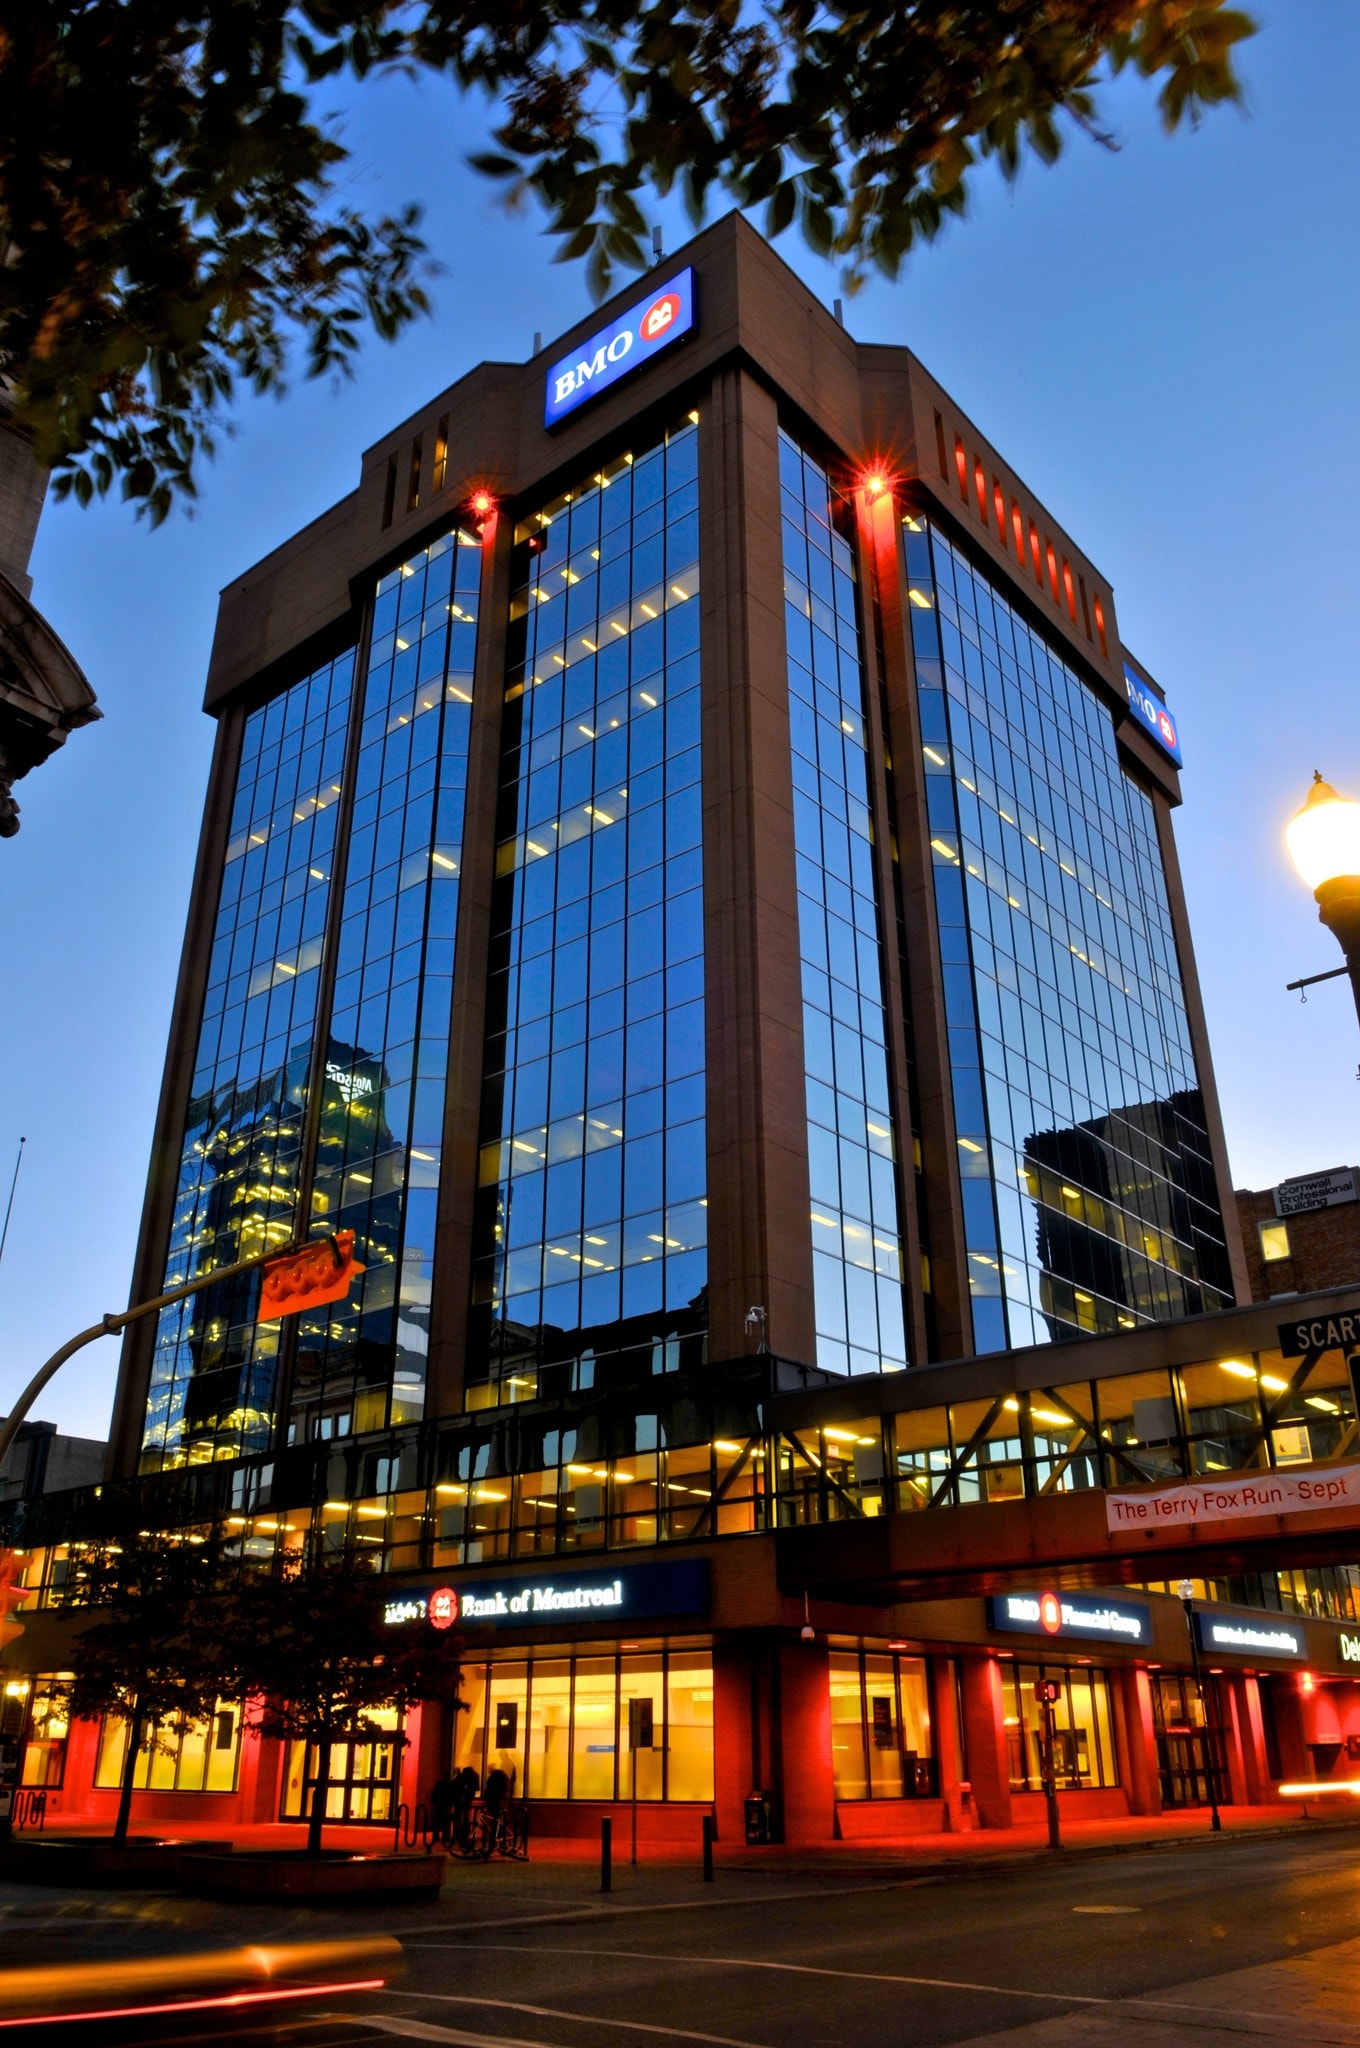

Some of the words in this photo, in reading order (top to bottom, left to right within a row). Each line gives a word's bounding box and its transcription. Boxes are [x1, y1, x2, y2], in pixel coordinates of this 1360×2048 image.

[554, 331, 633, 404] BMO
[1278, 1177, 1331, 1196] Cornwall
[1279, 1181, 1353, 1206] Professional
[1281, 1197, 1327, 1213] Building
[1113, 1502, 1147, 1520] The
[1151, 1497, 1198, 1517] Terry
[1203, 1492, 1238, 1510] Fox
[1243, 1487, 1282, 1506] Run
[1298, 1478, 1348, 1501] Sept
[462, 1591, 508, 1617] Bank
[510, 1590, 530, 1613] of
[533, 1580, 622, 1611] Montreal
[1340, 1633, 1360, 1661] Del
